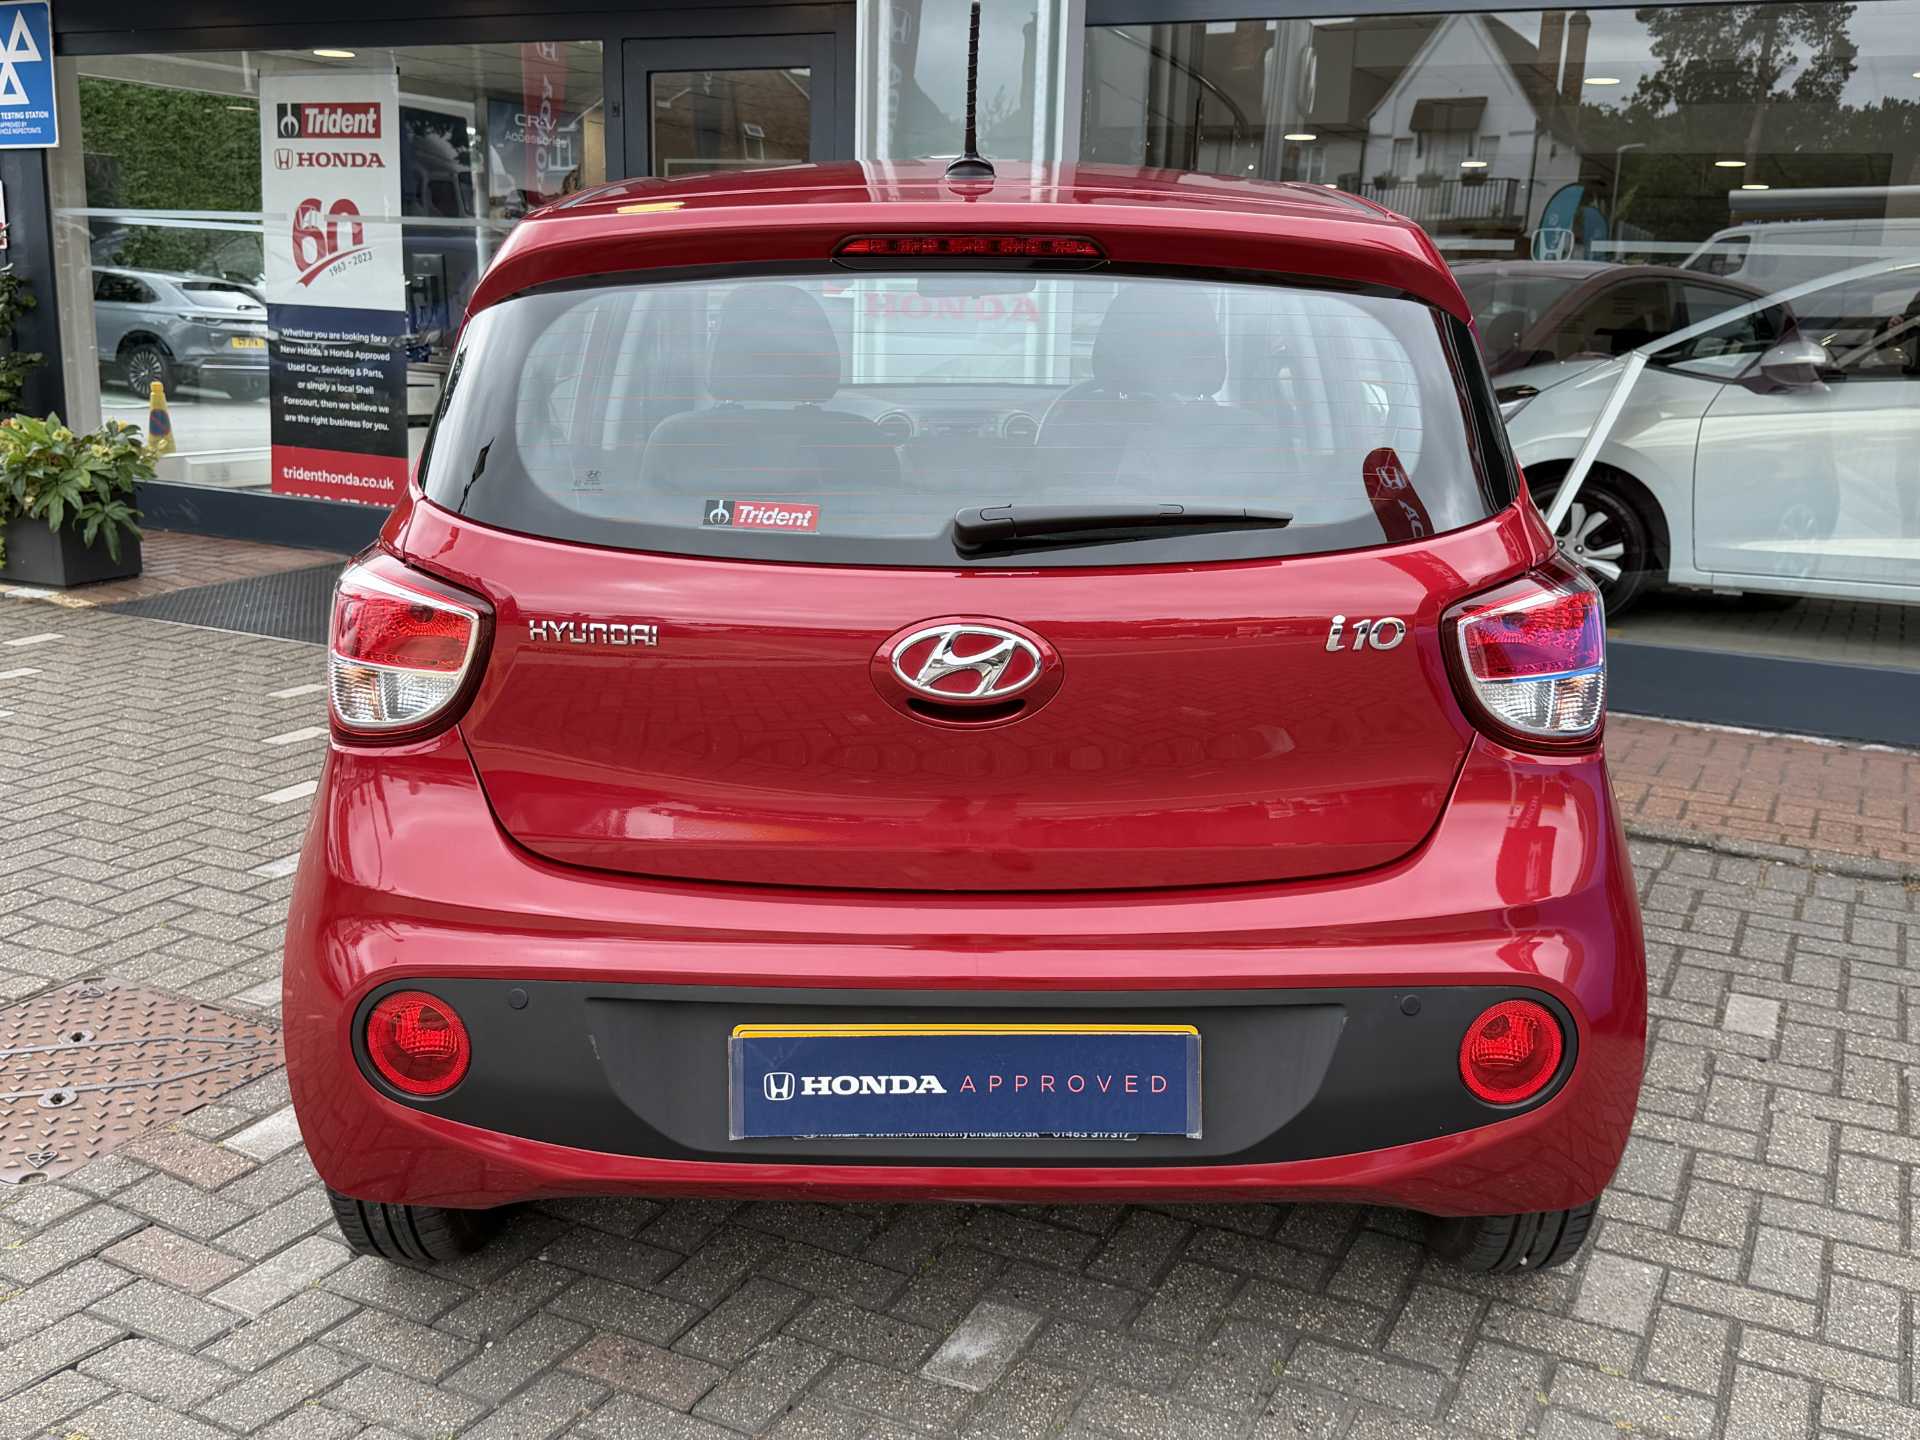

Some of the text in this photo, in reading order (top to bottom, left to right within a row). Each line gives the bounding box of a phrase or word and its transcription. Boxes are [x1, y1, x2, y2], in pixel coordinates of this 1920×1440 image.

[25, 111, 49, 119] STATION
[305, 107, 377, 134] Trident
[296, 152, 386, 169] HONDA
[329, 261, 346, 277] 1963
[352, 250, 373, 266] 2023
[864, 292, 1041, 322] HONDA
[282, 328, 313, 339] Whether
[314, 331, 328, 341] you
[342, 331, 369, 343] looking
[370, 334, 381, 342] for
[280, 345, 296, 354] New
[329, 350, 353, 358] Honda
[355, 351, 390, 362] Approved
[287, 363, 384, 380] Used Car, Servicing & Parts,
[307, 381, 330, 393] simply
[337, 383, 354, 393] local
[356, 385, 374, 395] Shell
[283, 395, 390, 414] Forecourt, then we believe we
[284, 414, 390, 431] are the right business for you.
[283, 466, 395, 490] tridenthonda.co.uk
[739, 505, 812, 527] Trident
[529, 619, 658, 646] HYUNDAI
[1325, 614, 1407, 652] i10
[801, 1074, 1167, 1095] HONDA APPROVED
